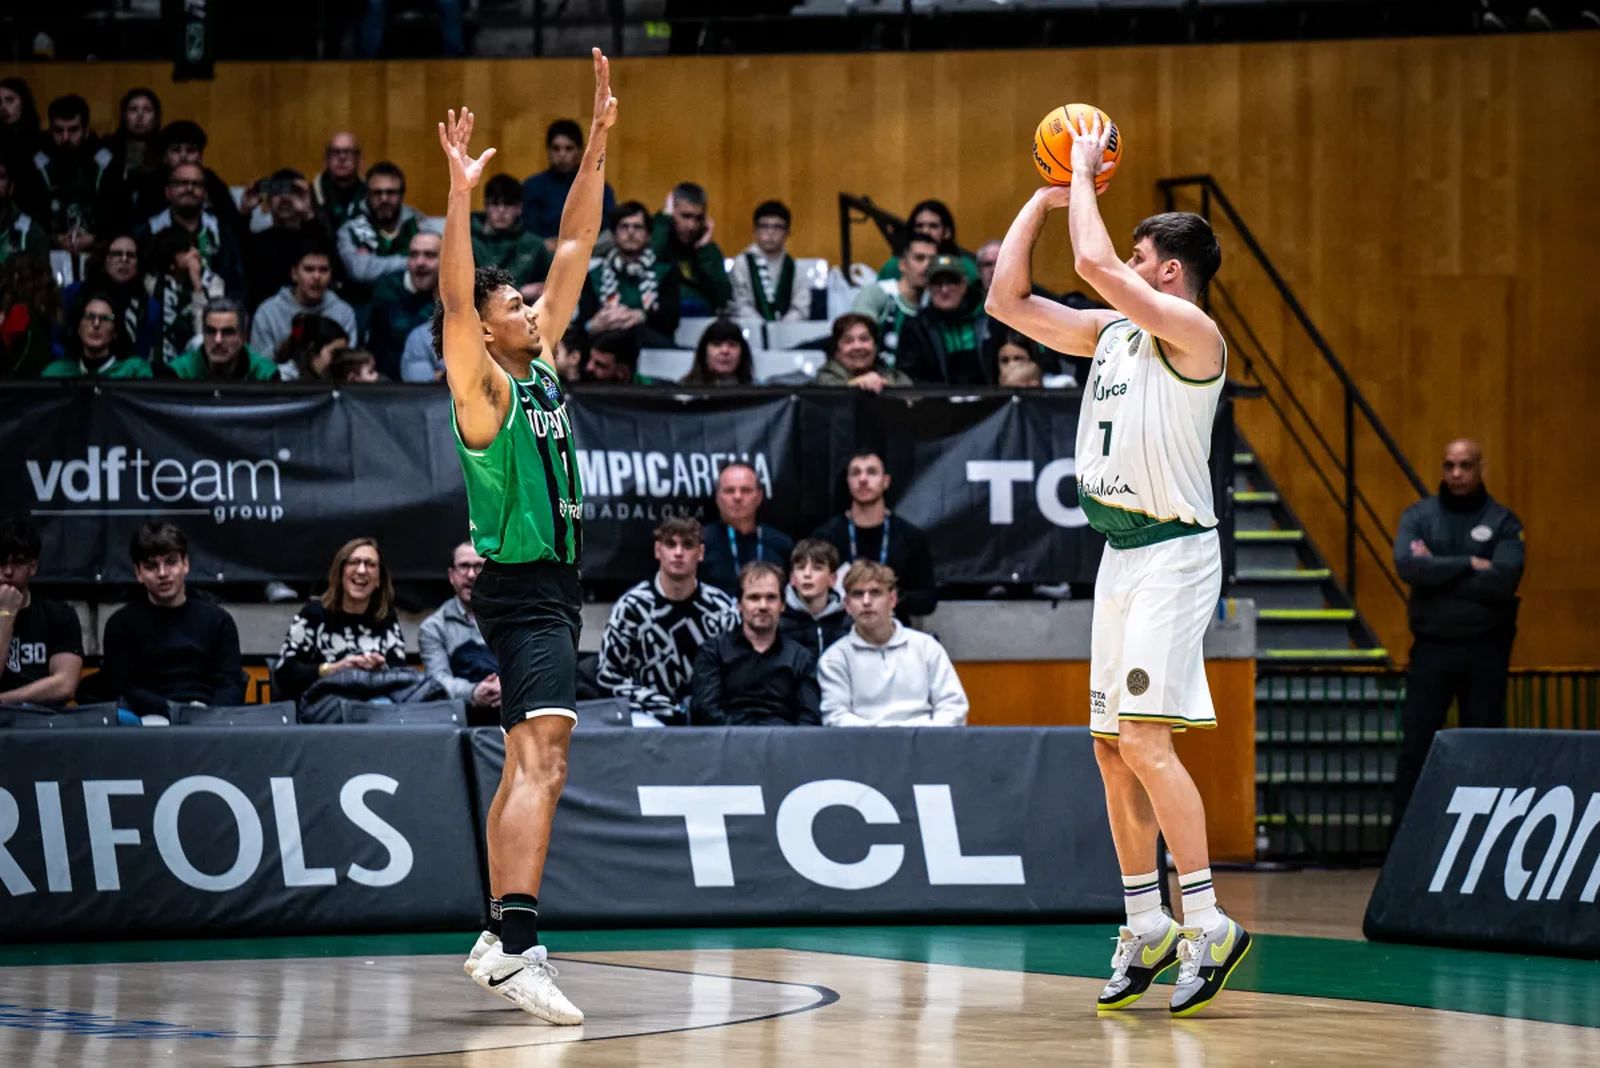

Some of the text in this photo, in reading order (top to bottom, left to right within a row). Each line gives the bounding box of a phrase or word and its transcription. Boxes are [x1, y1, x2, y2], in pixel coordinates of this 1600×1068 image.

[1098, 421, 1113, 457] 7
[214, 505, 284, 524] group
[20, 641, 47, 665] 30
[0, 773, 414, 897] RIFOLS
[637, 779, 1026, 891] TCL
